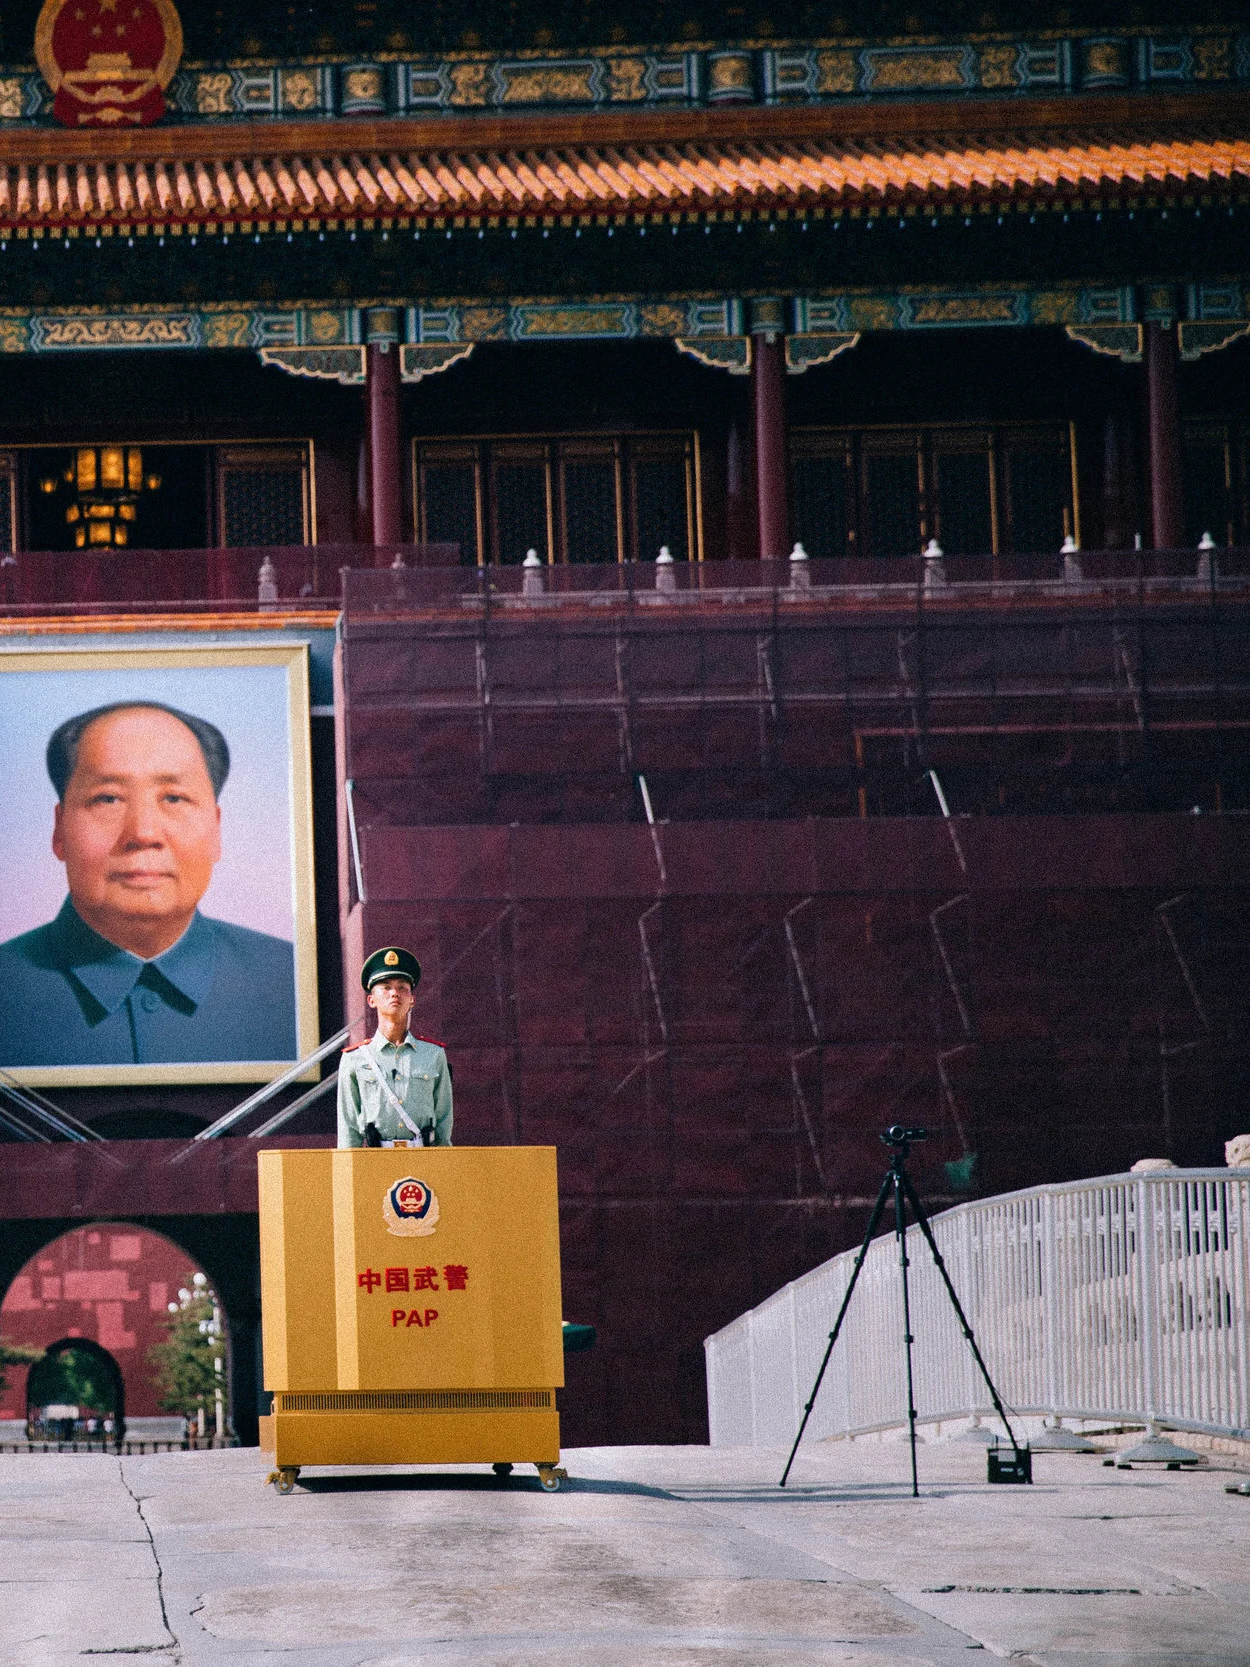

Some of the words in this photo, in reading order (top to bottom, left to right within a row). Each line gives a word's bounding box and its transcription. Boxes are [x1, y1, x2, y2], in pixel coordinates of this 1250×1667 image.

[358, 1264, 469, 1294] 中国武警
[392, 1310, 439, 1328] PAP
